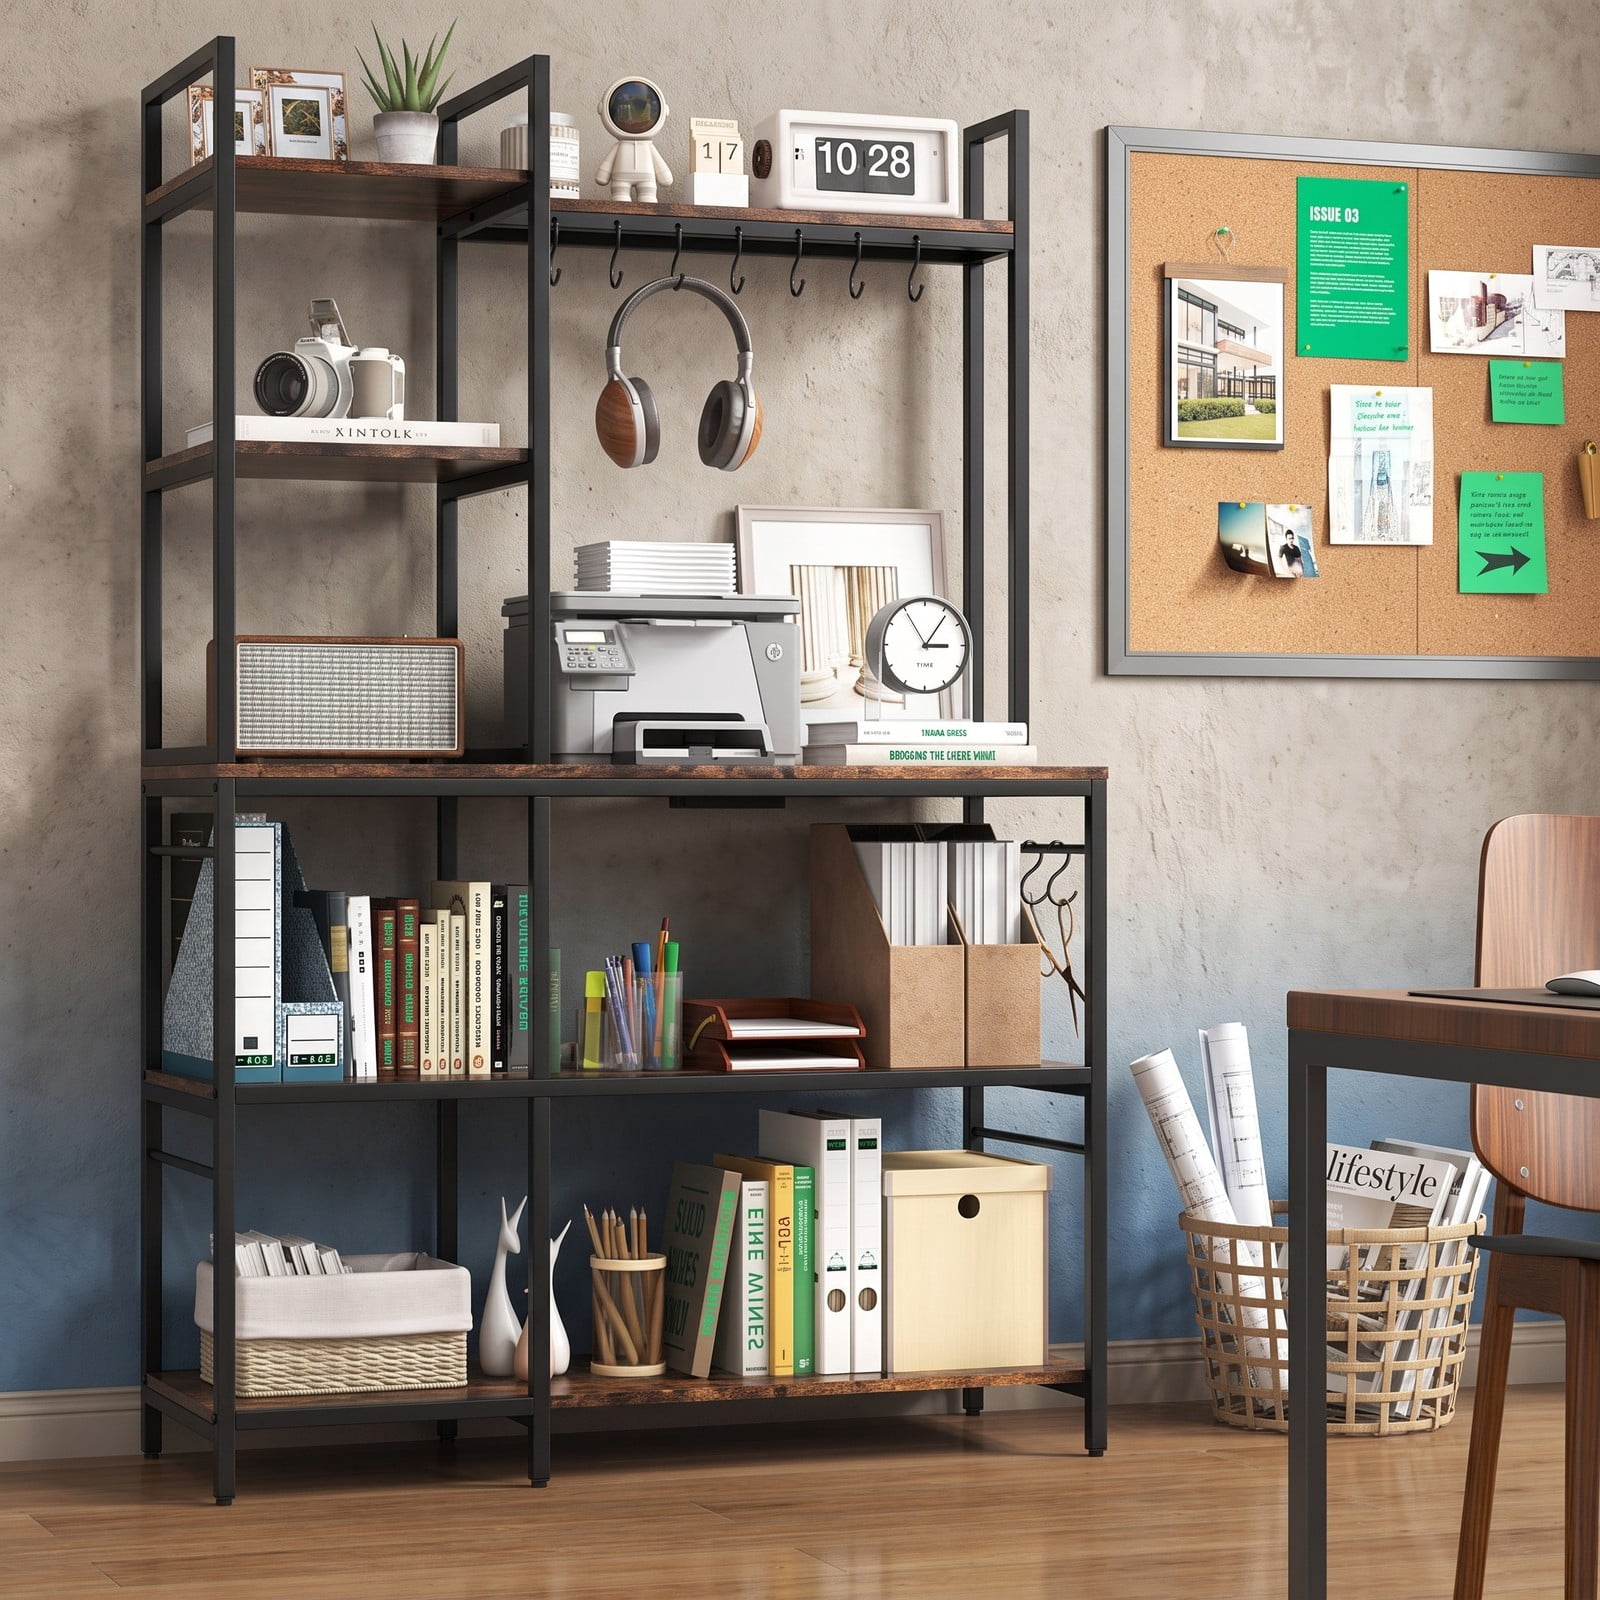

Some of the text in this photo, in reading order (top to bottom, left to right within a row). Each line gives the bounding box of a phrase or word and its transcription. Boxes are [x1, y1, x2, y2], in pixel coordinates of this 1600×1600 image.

[818, 141, 911, 178] 10 28
[1309, 205, 1360, 223] ISSUE 03
[335, 427, 412, 439] XINTOLK
[929, 750, 945, 761] THE
[1326, 1149, 1437, 1202] lifestyle
